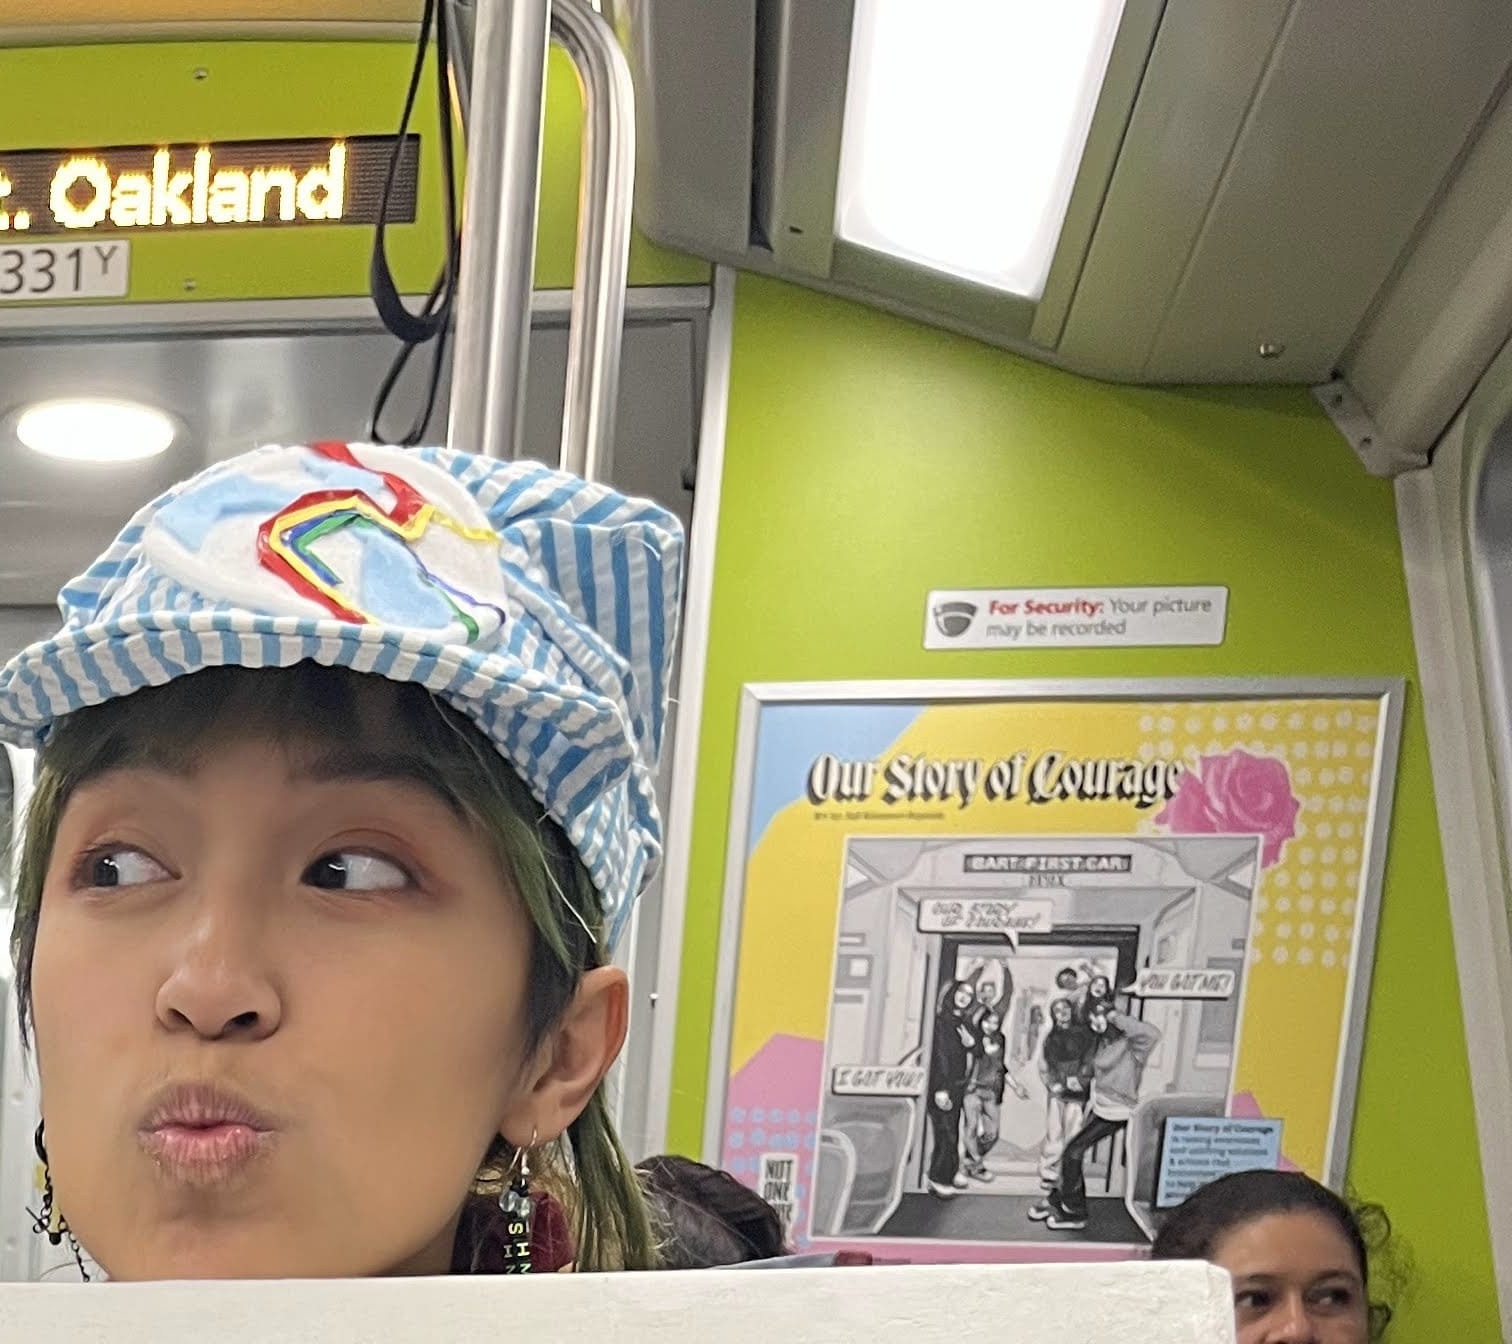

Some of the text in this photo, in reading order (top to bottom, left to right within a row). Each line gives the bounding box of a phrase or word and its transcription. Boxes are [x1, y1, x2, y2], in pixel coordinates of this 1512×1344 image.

[49, 140, 347, 229] Oakland
[989, 596, 1212, 618] For Security: Your picture
[986, 619, 1127, 640] may be recorded
[808, 750, 1186, 810] Our Story of Courage
